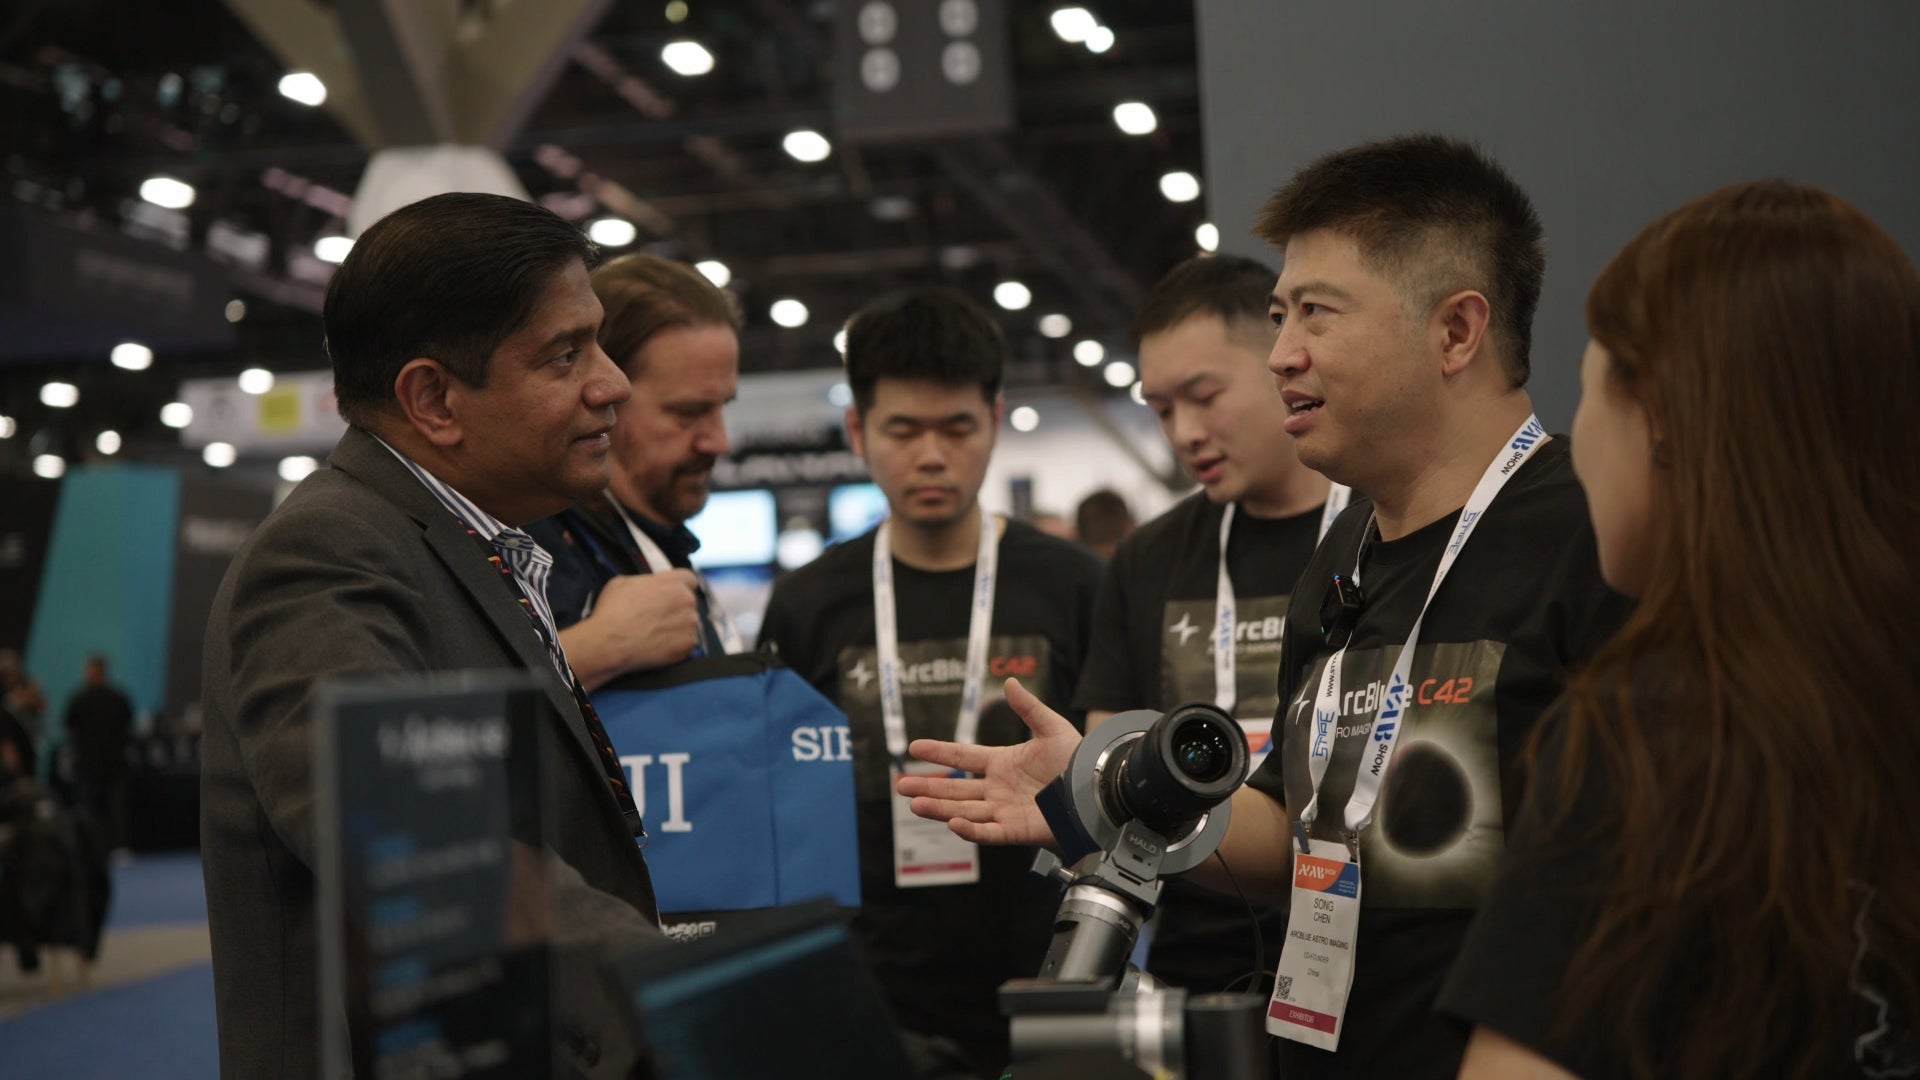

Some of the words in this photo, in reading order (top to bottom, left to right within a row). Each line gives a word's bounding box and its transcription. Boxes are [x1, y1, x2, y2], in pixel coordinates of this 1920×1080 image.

[1501, 451, 1523, 475] SHOW
[1337, 680, 1414, 717] rcBle
[1418, 677, 1473, 705] C42
[1374, 673, 1404, 742] NAB
[1371, 744, 1388, 776] SHOW
[1130, 834, 1157, 854] HALO
[1314, 898, 1334, 912] SONG
[1314, 912, 1330, 924] CHEN
[1290, 930, 1312, 942] ARCBLUE
[1312, 934, 1328, 946] ASTRO
[1329, 939, 1348, 950] IMAGING
